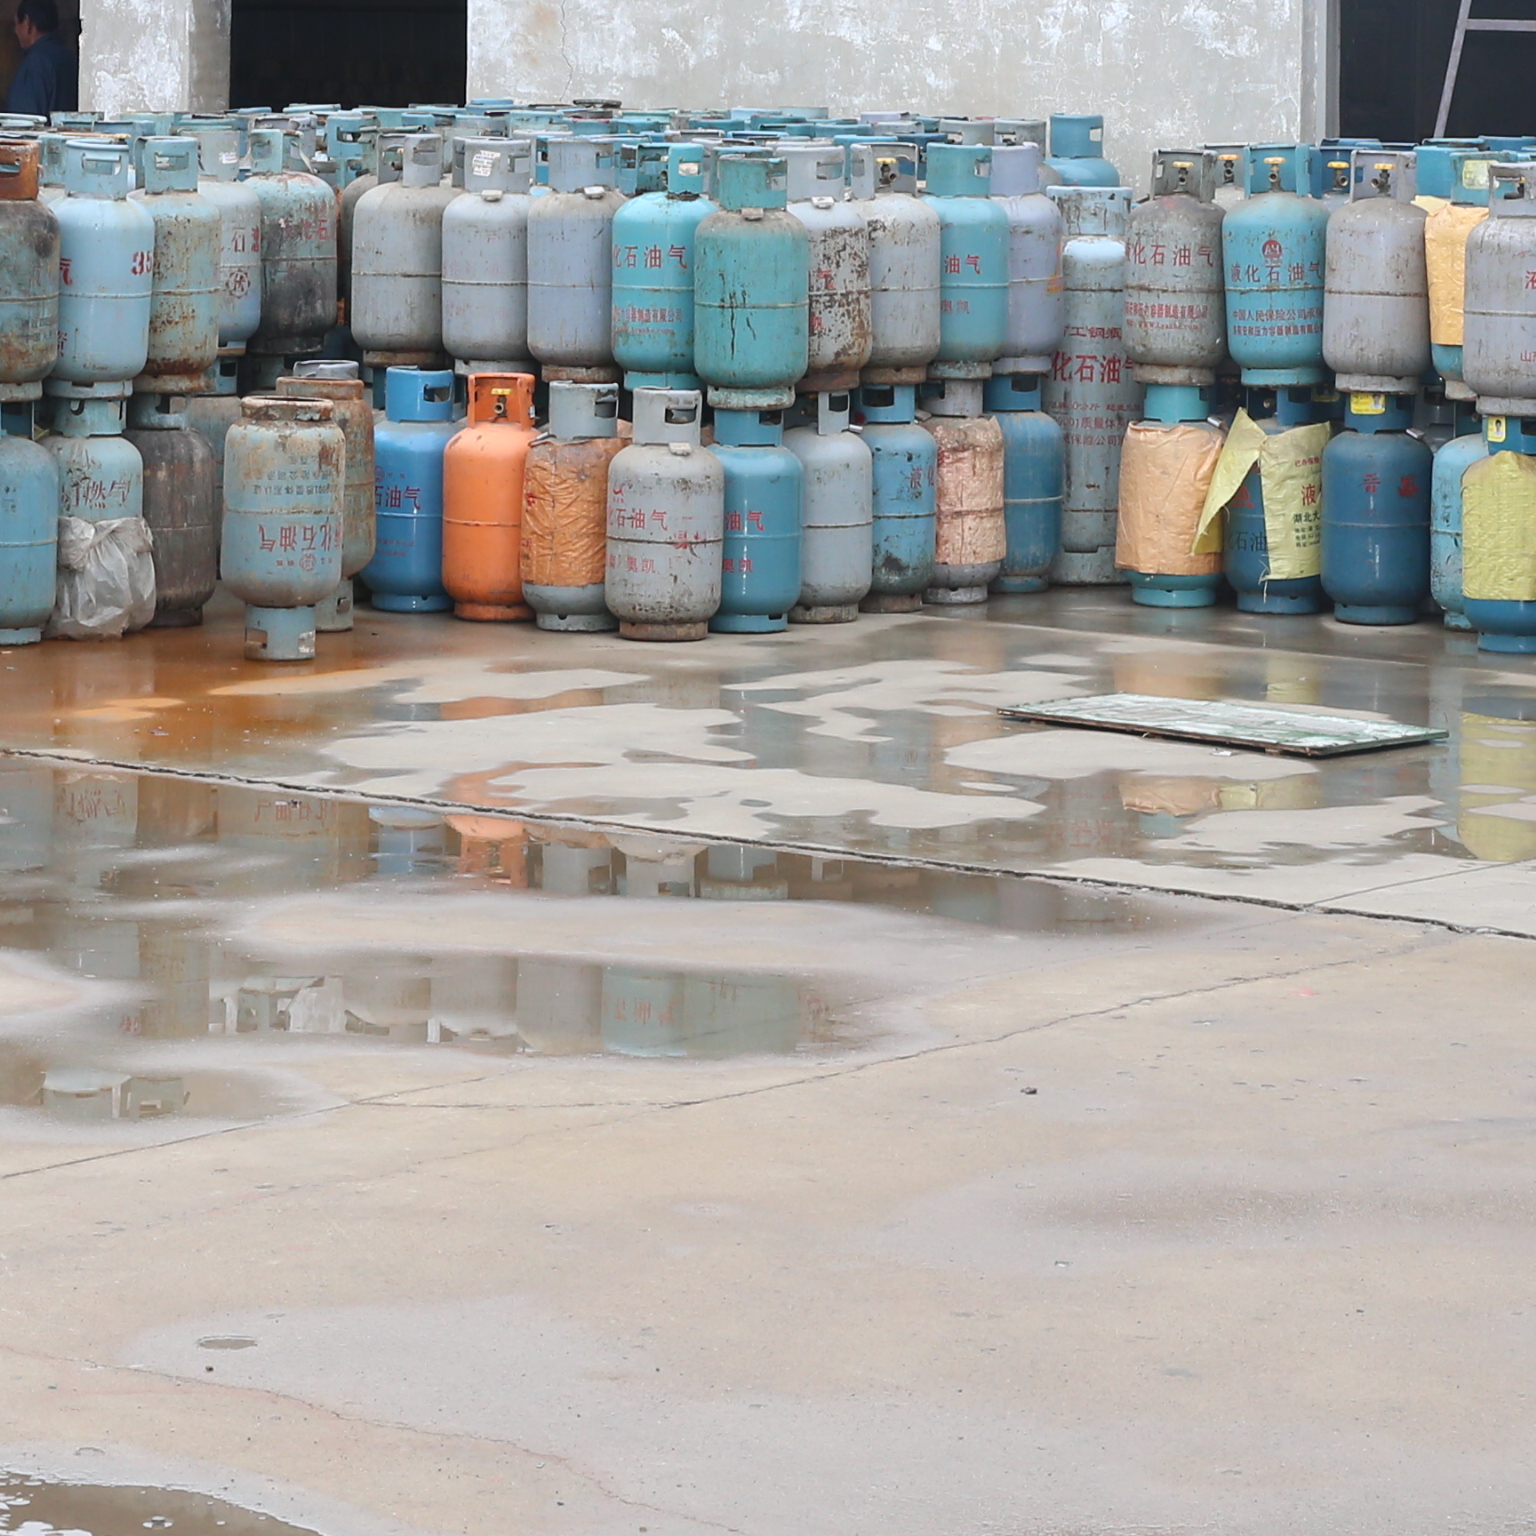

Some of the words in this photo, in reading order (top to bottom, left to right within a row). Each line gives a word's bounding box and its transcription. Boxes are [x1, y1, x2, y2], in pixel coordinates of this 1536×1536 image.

[944, 254, 981, 275] 油气
[1231, 261, 1322, 282] 液化石油气
[1044, 350, 1134, 384] 化石油
[1302, 483, 1317, 506] 液
[726, 511, 765, 531] 油气
